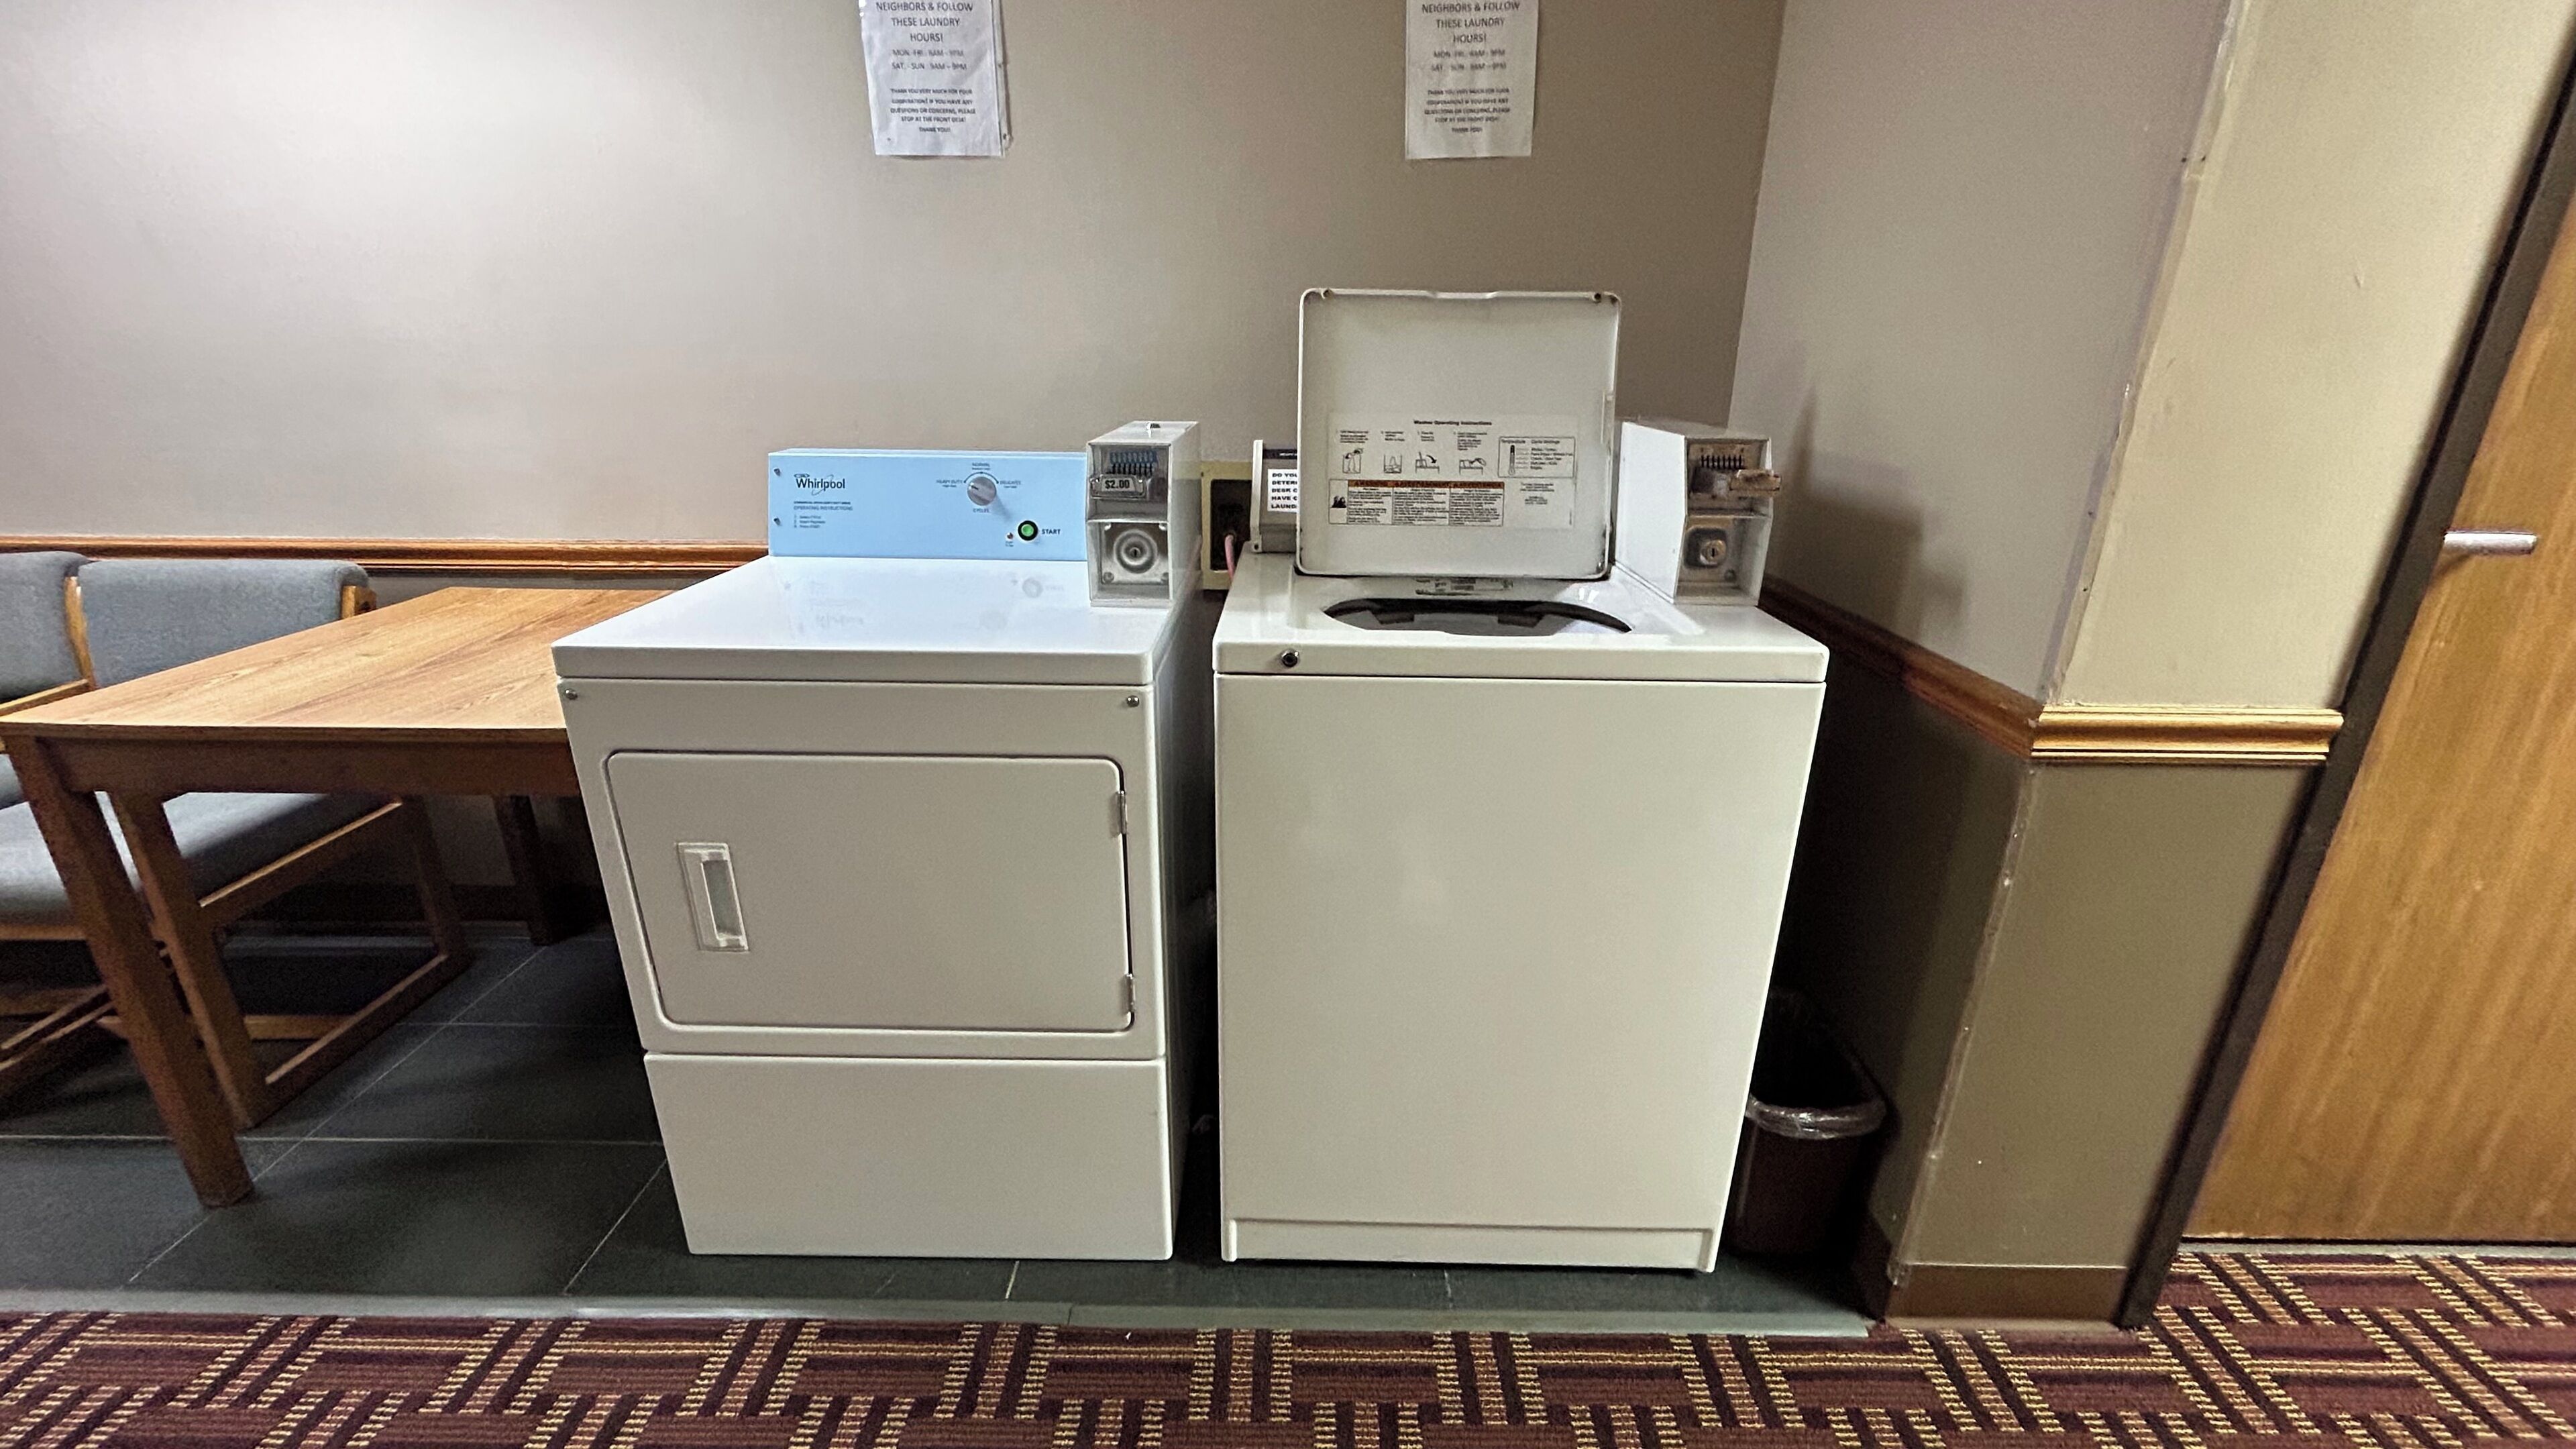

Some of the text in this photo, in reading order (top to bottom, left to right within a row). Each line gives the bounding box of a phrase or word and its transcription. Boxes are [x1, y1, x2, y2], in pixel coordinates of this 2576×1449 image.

[875, 2, 973, 11] NEIGHBORS & FOLLOW
[1422, 1, 1520, 13] NEIGHBORS & FOLLOW
[891, 17, 961, 26] THESE LAUNDRY
[1436, 17, 1505, 28] THESE LAUNDRY
[910, 33, 943, 42] HOURS!
[1453, 33, 1487, 43] HOURS!
[796, 478, 846, 492] Whirlpool
[1104, 480, 1130, 489] $2.00
